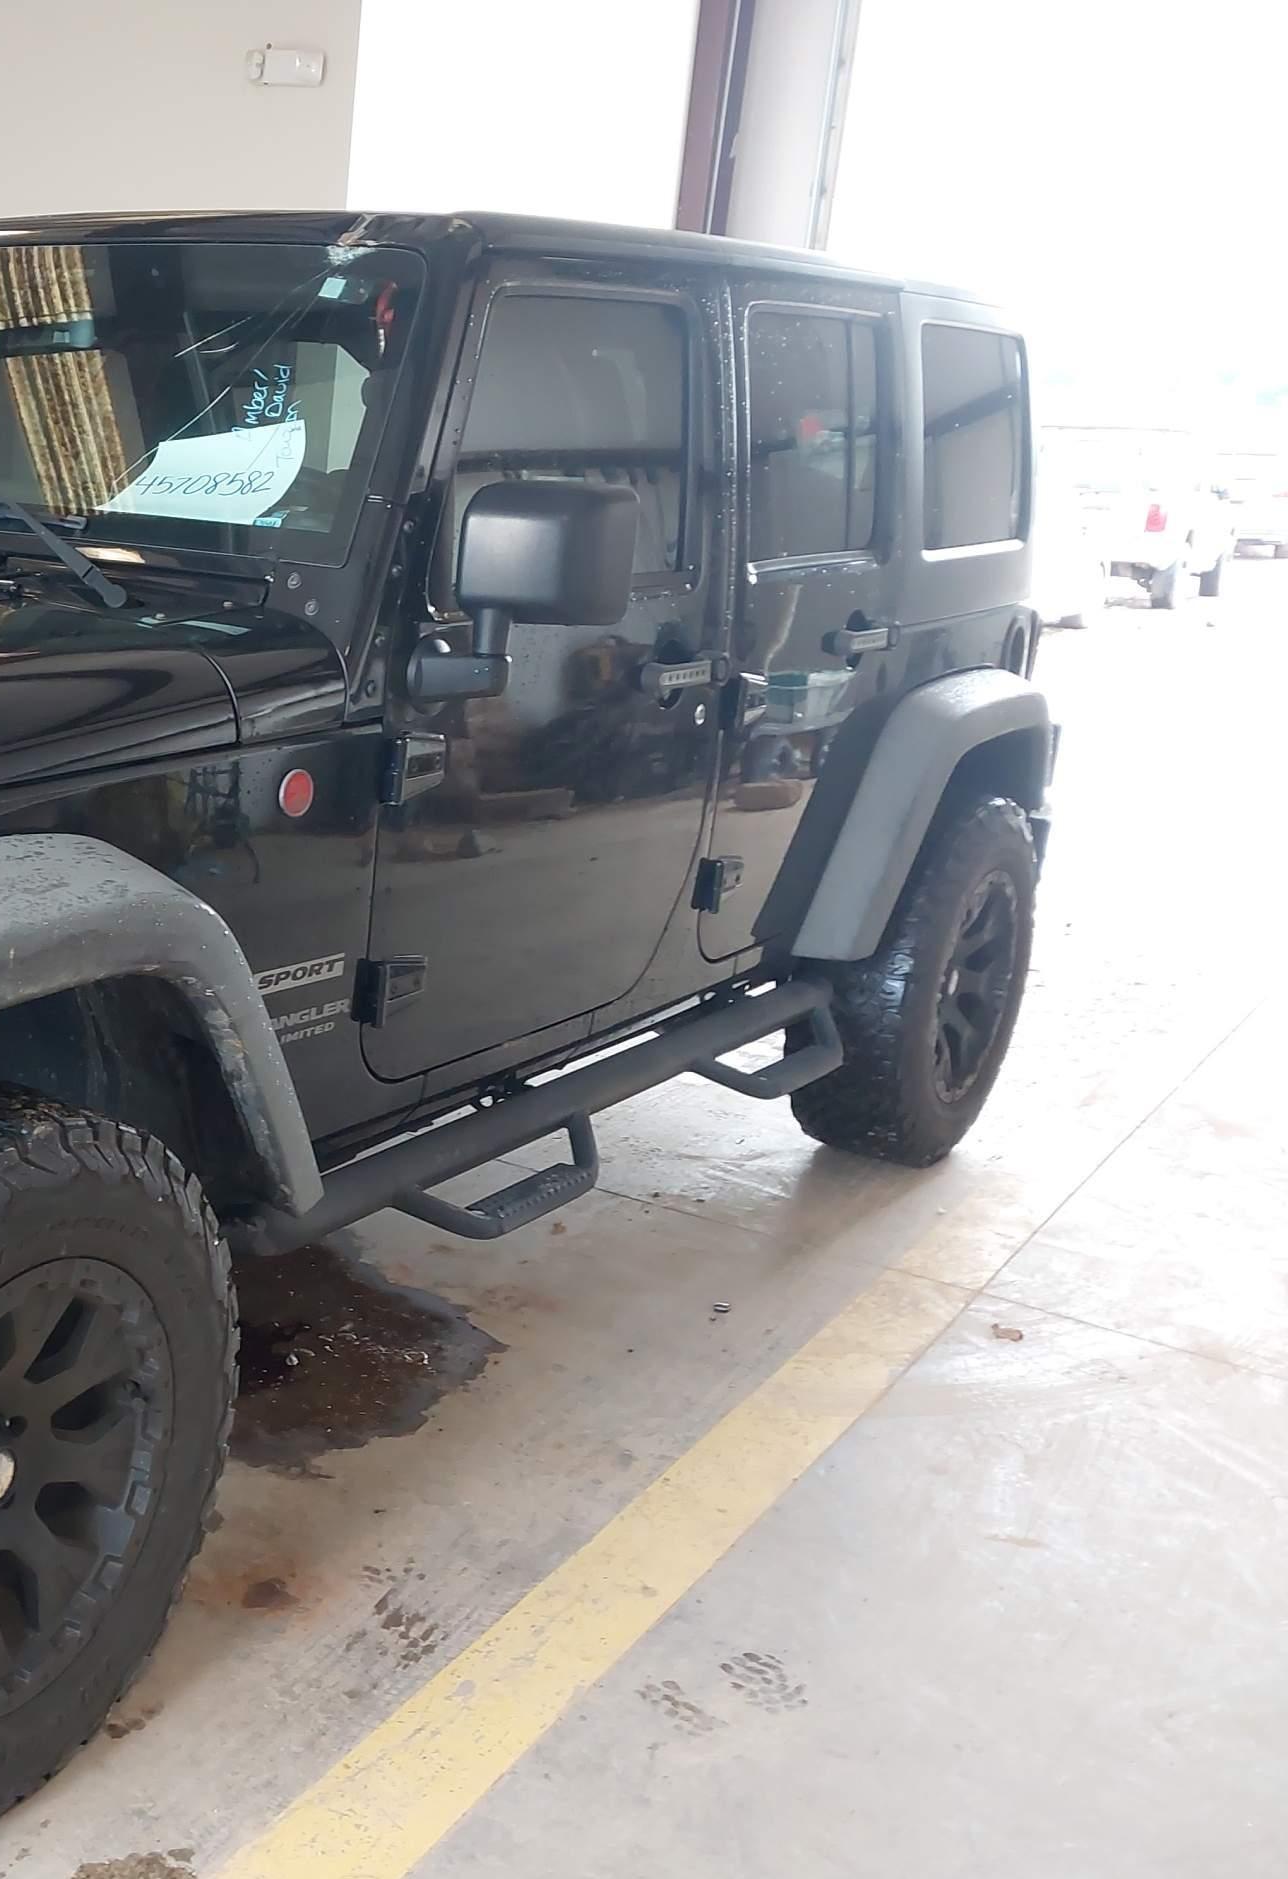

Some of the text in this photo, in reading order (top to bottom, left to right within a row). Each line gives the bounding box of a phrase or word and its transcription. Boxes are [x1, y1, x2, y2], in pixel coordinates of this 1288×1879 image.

[265, 364, 293, 418] David
[135, 470, 276, 496] 45708582
[257, 959, 340, 991] SPORT
